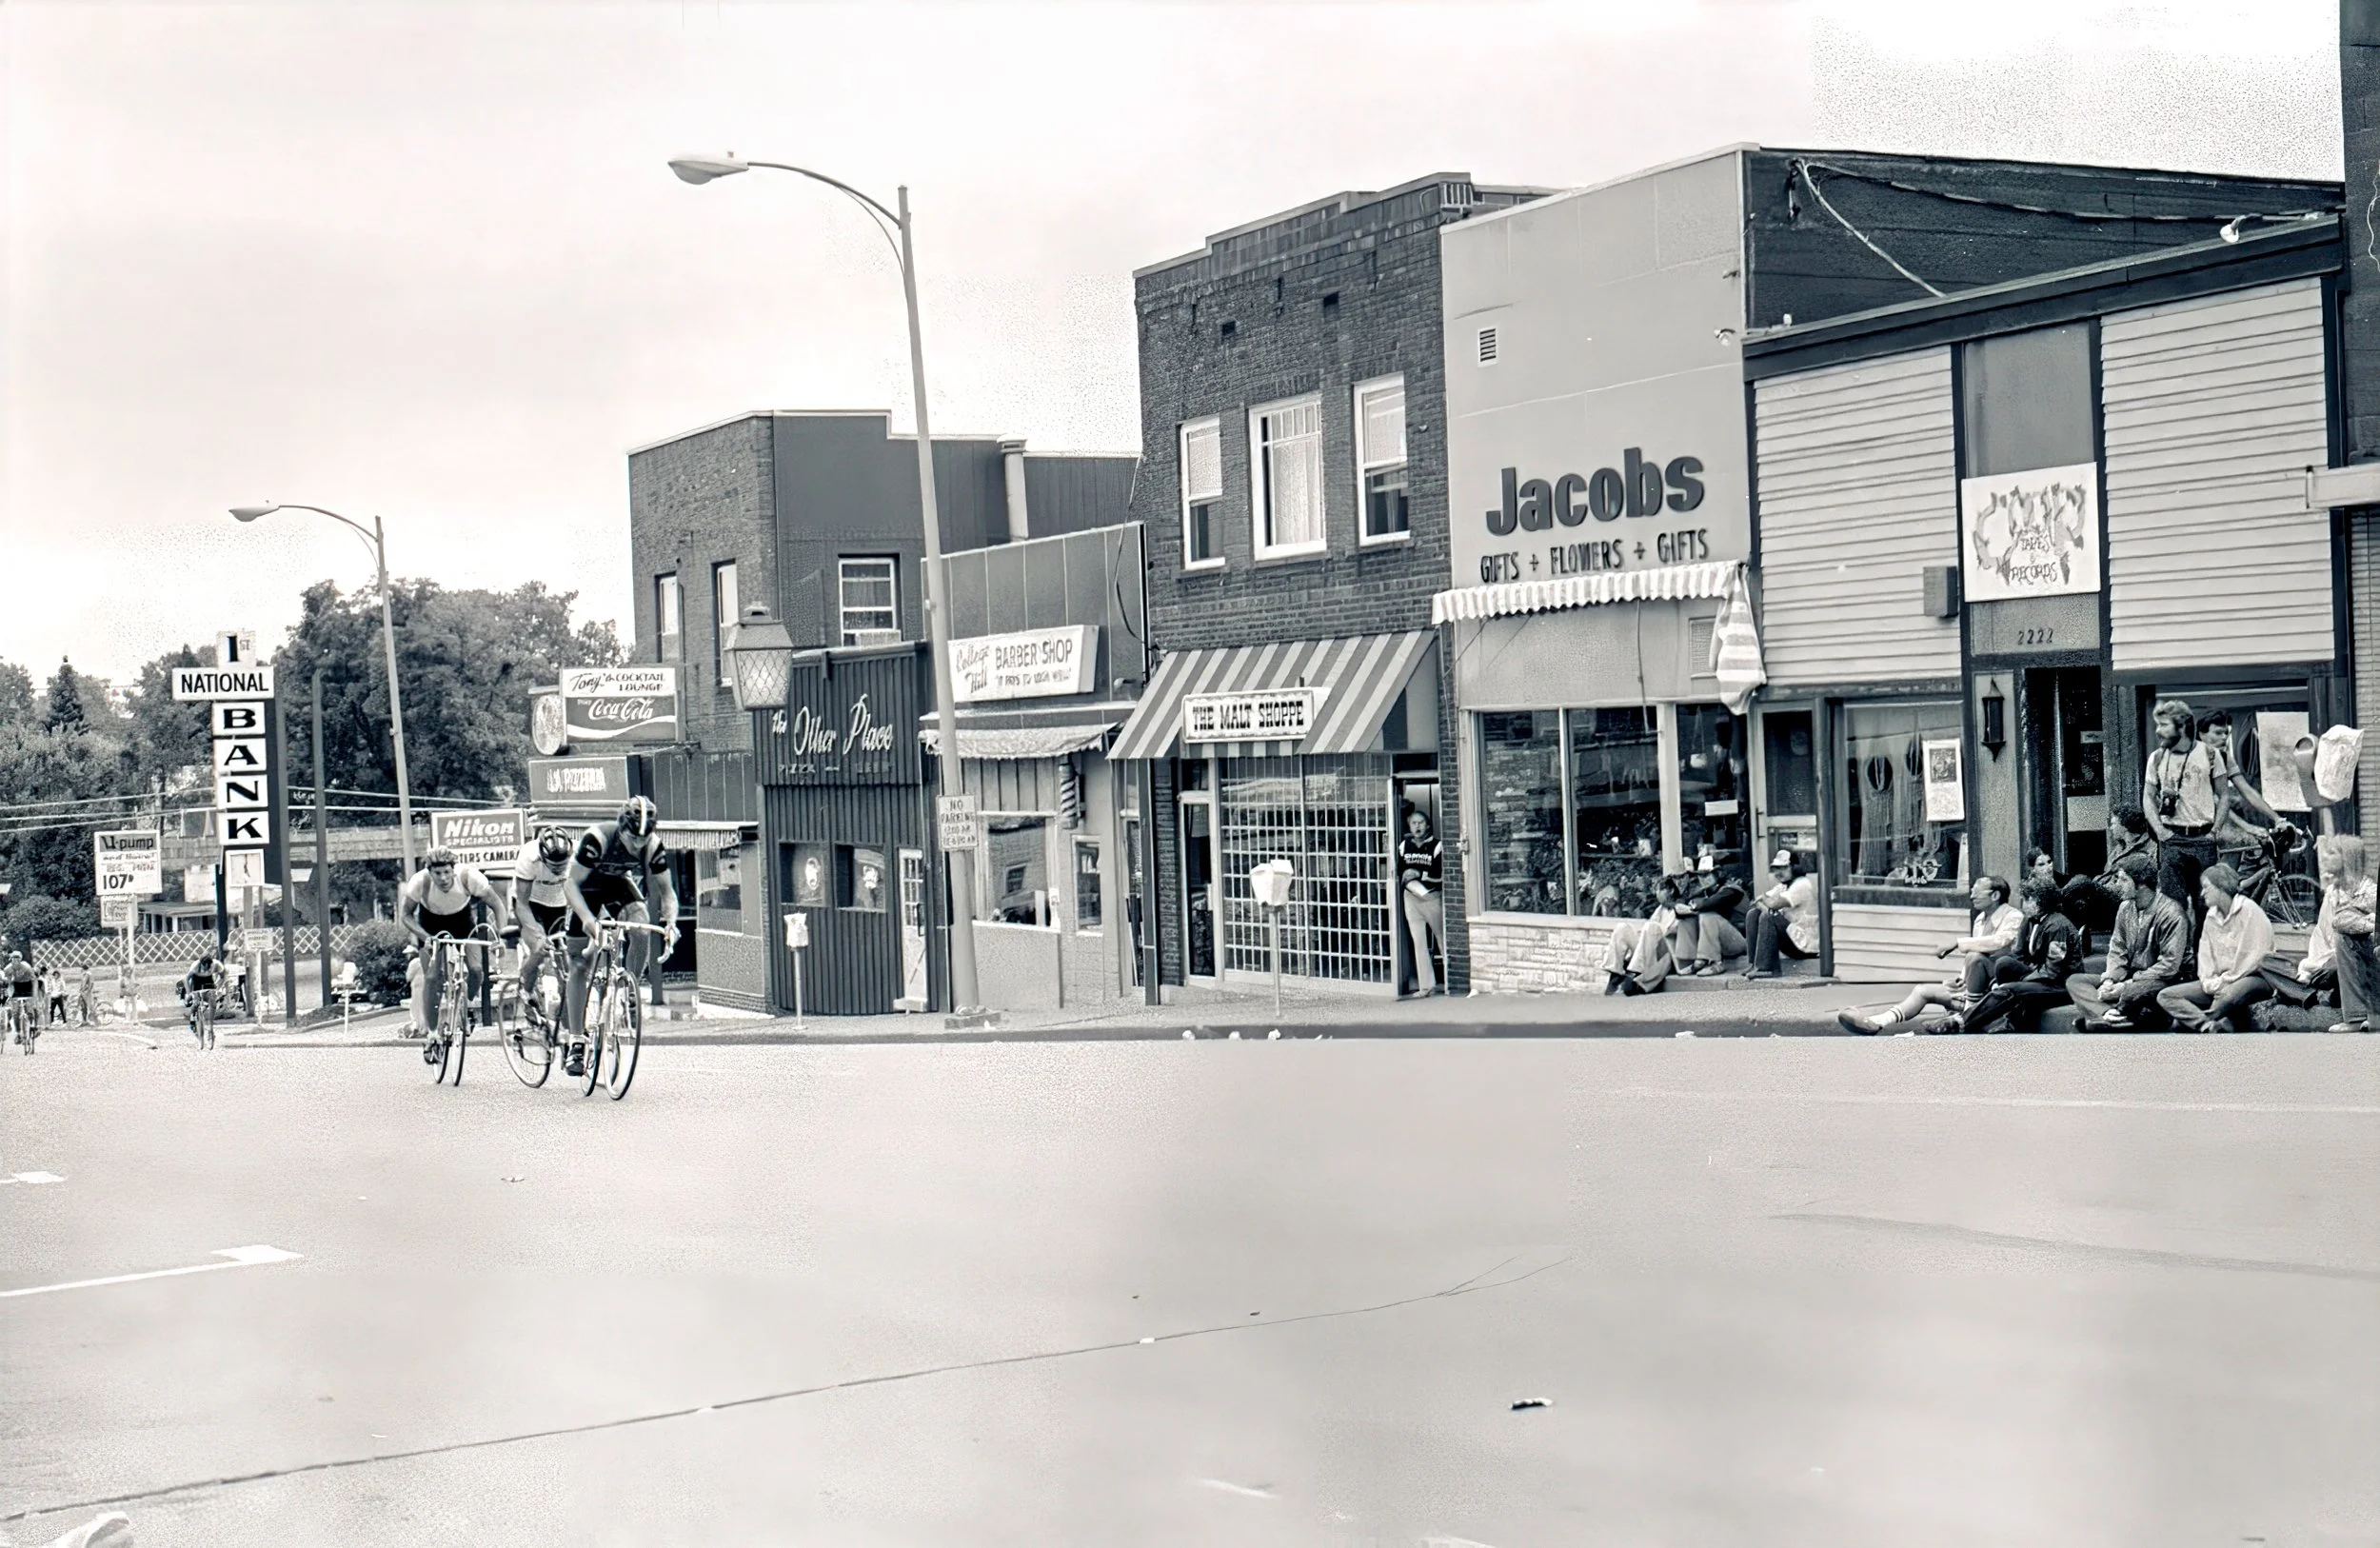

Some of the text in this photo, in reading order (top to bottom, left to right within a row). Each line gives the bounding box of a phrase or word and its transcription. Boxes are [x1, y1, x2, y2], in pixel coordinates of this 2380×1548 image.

[1486, 447, 1705, 536] Jacobs
[1480, 551, 1520, 584] GIFTS
[1550, 539, 1625, 575] FLOWERS
[1657, 528, 1710, 564] GIFTS
[2011, 562, 2057, 585] RECORDS
[2018, 628, 2054, 645] 2222
[995, 643, 1038, 670] BARBER
[1041, 639, 1073, 665] SHOP
[181, 672, 269, 693] NATIONAL
[616, 672, 664, 682] COCKTAIL
[619, 683, 664, 692] LOUNGE
[843, 693, 893, 755] Place
[1193, 700, 1304, 730] THE MALT SHOPPE
[224, 708, 263, 839] BANK
[444, 818, 515, 838] Nikon
